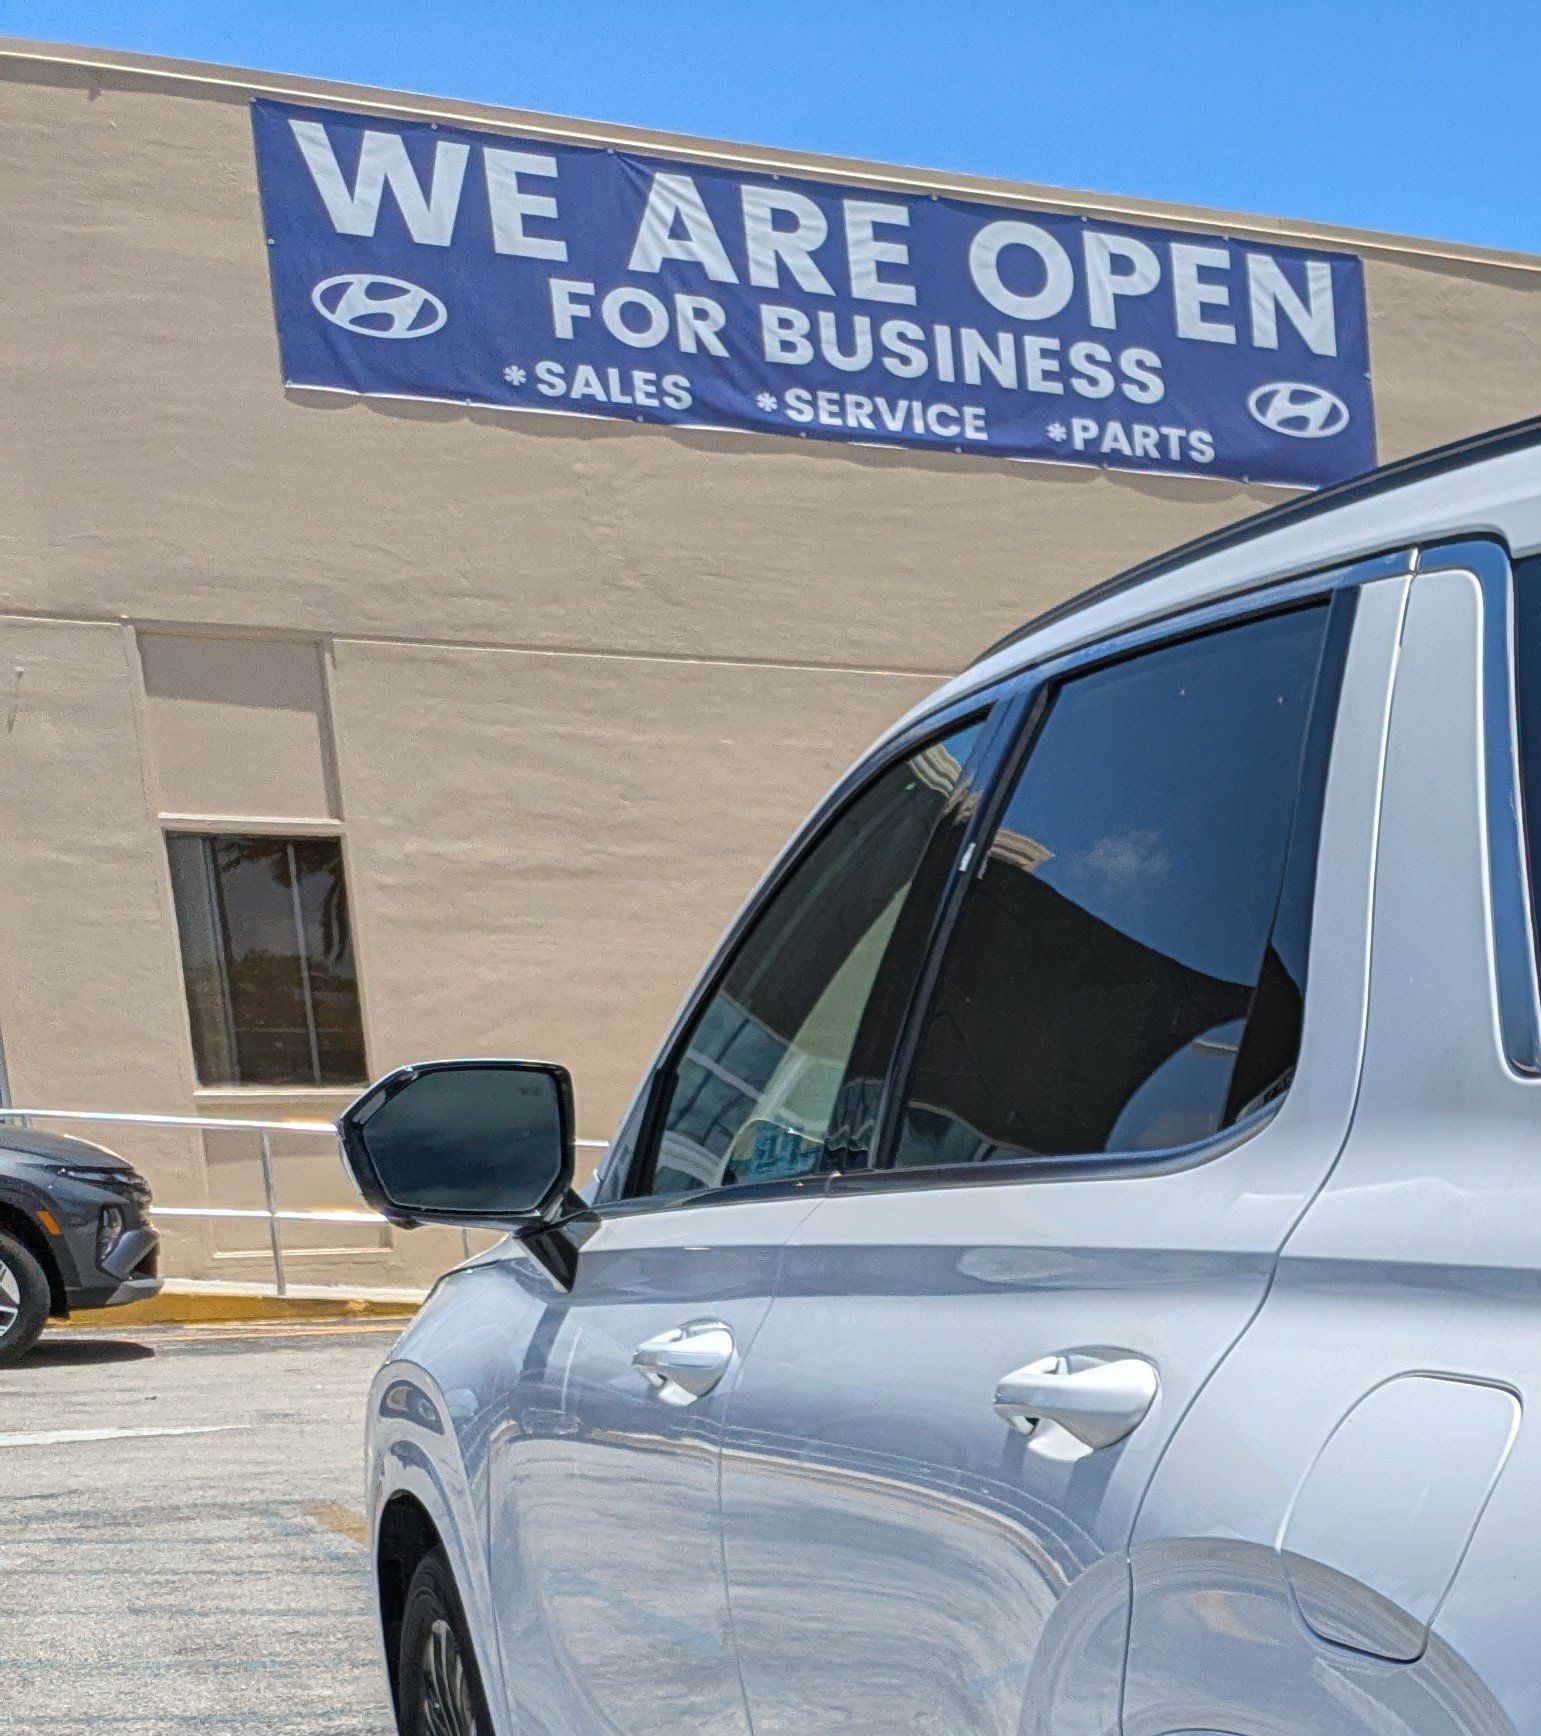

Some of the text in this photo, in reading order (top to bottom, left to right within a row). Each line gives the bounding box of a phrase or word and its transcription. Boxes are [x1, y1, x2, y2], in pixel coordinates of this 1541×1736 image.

[286, 118, 1338, 357] WE ARE OPEN
[548, 277, 1165, 404] FOR BUSINESS
